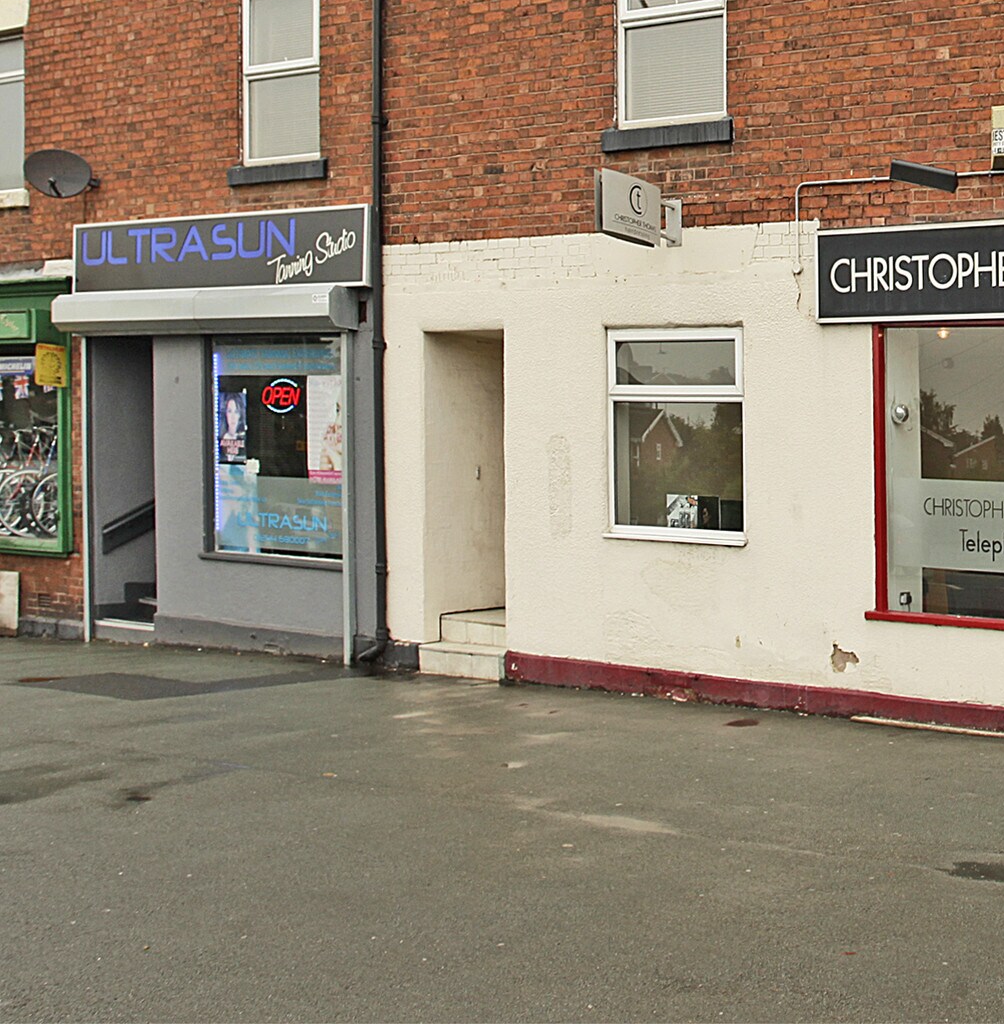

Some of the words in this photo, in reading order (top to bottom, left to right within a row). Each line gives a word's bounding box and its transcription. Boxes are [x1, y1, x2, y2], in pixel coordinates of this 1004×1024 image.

[81, 218, 296, 266] ULTRASUN
[266, 253, 314, 284] Tanning
[315, 228, 356, 265] Studio
[261, 386, 301, 406] OPEN
[237, 511, 328, 533] ULTRASUN
